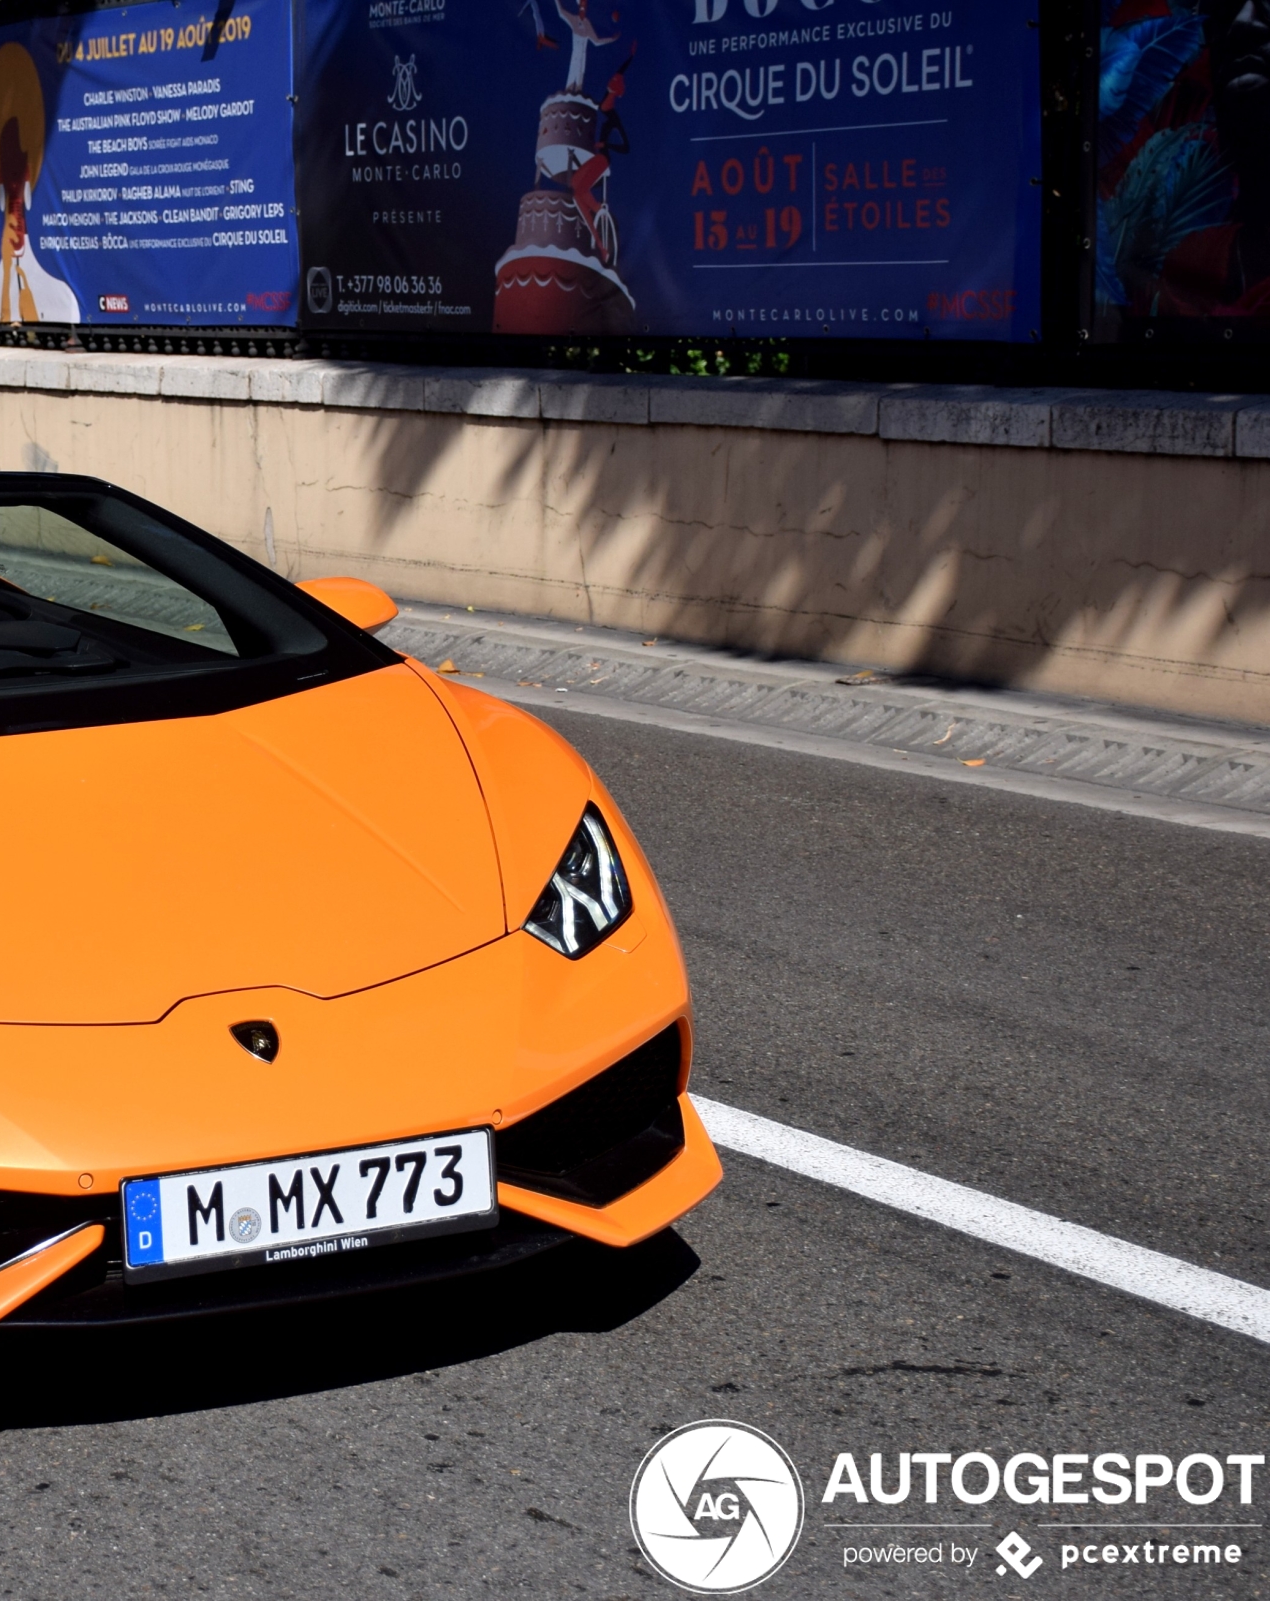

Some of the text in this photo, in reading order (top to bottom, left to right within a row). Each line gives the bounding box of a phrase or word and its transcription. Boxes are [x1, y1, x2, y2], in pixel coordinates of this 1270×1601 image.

[57, 15, 252, 64] DU 4 JUILLET AU 19 AOÛT 2019
[688, 11, 952, 56] UNE PERFORMANCE EXCLUSIVE DU
[83, 78, 220, 106] CHARLIE WINSTON VANESSA PARADIS
[669, 64, 785, 120] CIRQUE
[795, 58, 841, 103] DU
[57, 100, 254, 132] THE AUSTRALIAN PINK FLOYD SHOW MELODY GARDOT
[88, 140, 102, 154] THE
[102, 138, 127, 153] BEACH
[128, 136, 148, 152] BOYS
[344, 115, 468, 156] LE CASINO
[80, 164, 99, 178] JOHN
[100, 162, 128, 178] LEGEND
[691, 146, 802, 196] AOÛT
[824, 158, 947, 191] SALLE DES
[62, 189, 82, 202] PHILIP
[122, 186, 152, 200] RAGHEB
[154, 184, 181, 199] ALAMA
[230, 178, 254, 194] STING
[42, 202, 284, 226] MARCO MENGONI THE JACKSONS CLEAN BANDIT GRIGORY LEPS
[372, 209, 442, 224] PRÉSENTE
[694, 204, 802, 250] 15 AU 19
[824, 196, 951, 231] ÉTOILES
[40, 236, 69, 252] ENRIQUE
[70, 236, 98, 250] IGLESIAS
[102, 232, 128, 250] BÔCCA
[212, 230, 244, 248] CIRQUE
[245, 230, 257, 245] DU
[258, 228, 288, 244] SOLEIL
[311, 288, 328, 298] LIVE
[376, 275, 392, 294] 98
[394, 276, 409, 294] 06
[411, 276, 426, 294] 36
[428, 276, 442, 294] 36
[144, 303, 246, 312] MONTECARLOLIVE.COM
[712, 308, 920, 322] MONTECARLOLIVE.COM
[926, 290, 1018, 320] #MCSSF
[186, 1181, 224, 1246] M
[268, 1164, 344, 1234] MX
[358, 1144, 464, 1219] 773
[139, 1231, 152, 1249] D
[266, 1236, 368, 1262] Lamborghini Wien
